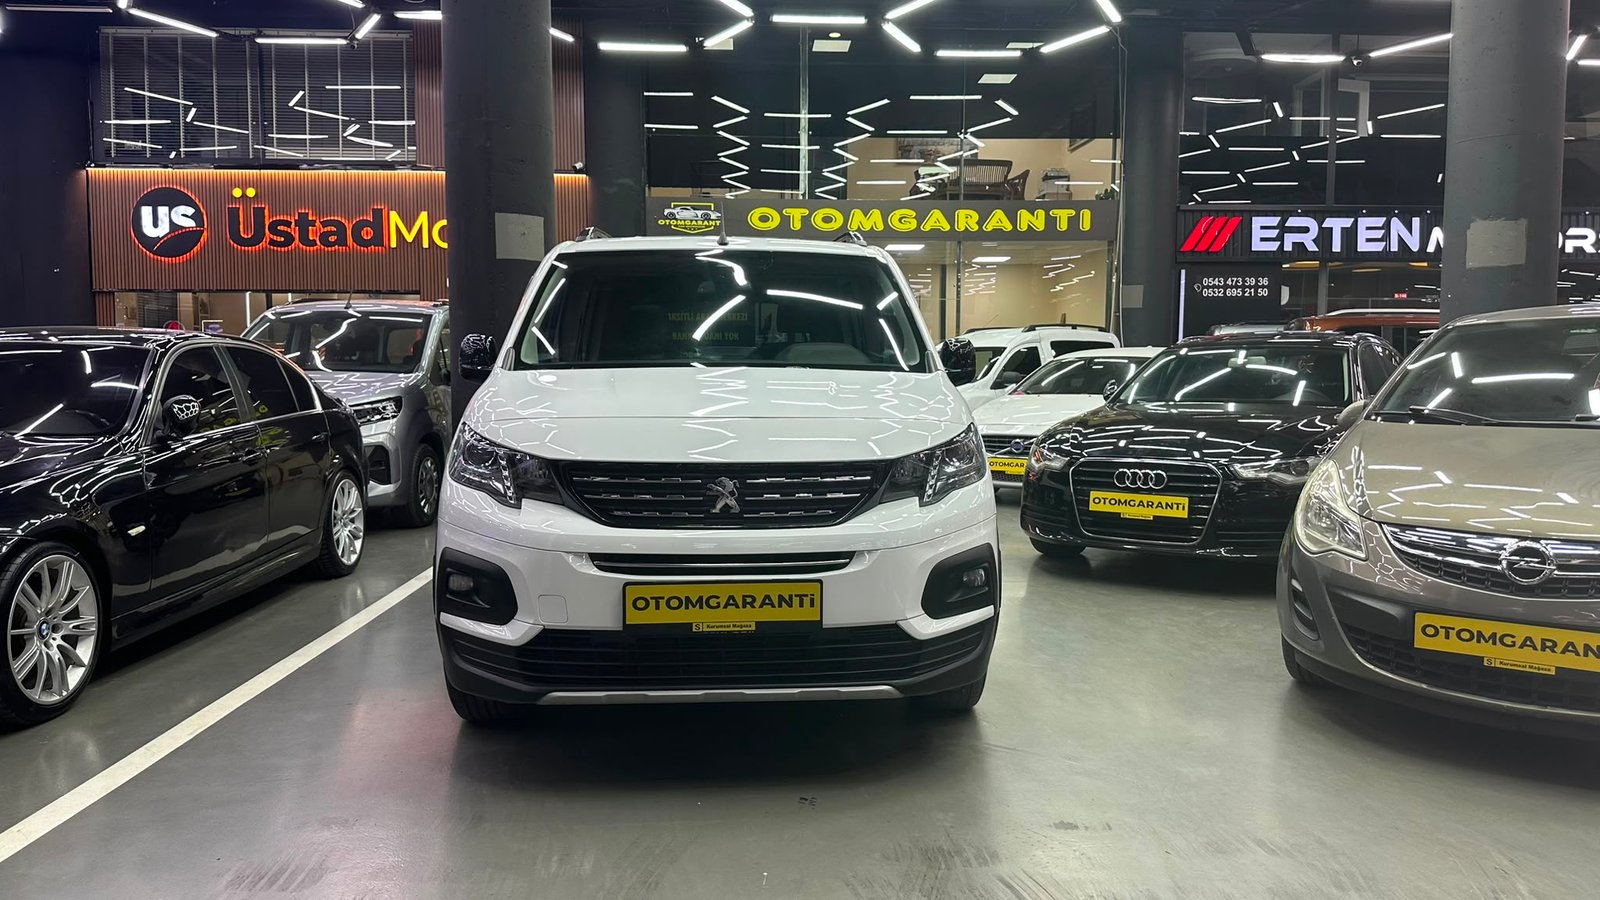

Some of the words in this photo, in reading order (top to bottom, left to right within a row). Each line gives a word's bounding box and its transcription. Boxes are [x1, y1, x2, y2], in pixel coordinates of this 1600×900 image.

[747, 207, 1091, 232] OTOMGARANTI
[1251, 216, 1420, 252] ERTEN
[1202, 277, 1224, 286] 0543
[1226, 277, 1243, 286] 473
[1244, 277, 1256, 286] 39
[1257, 277, 1269, 286] 36
[1202, 288, 1224, 297] 0532
[1226, 288, 1243, 297] 695
[1244, 288, 1255, 297] 21
[1257, 288, 1269, 297] 50
[631, 593, 815, 611] OTOMGARANTi
[1499, 660, 1527, 668] Kurumsal
